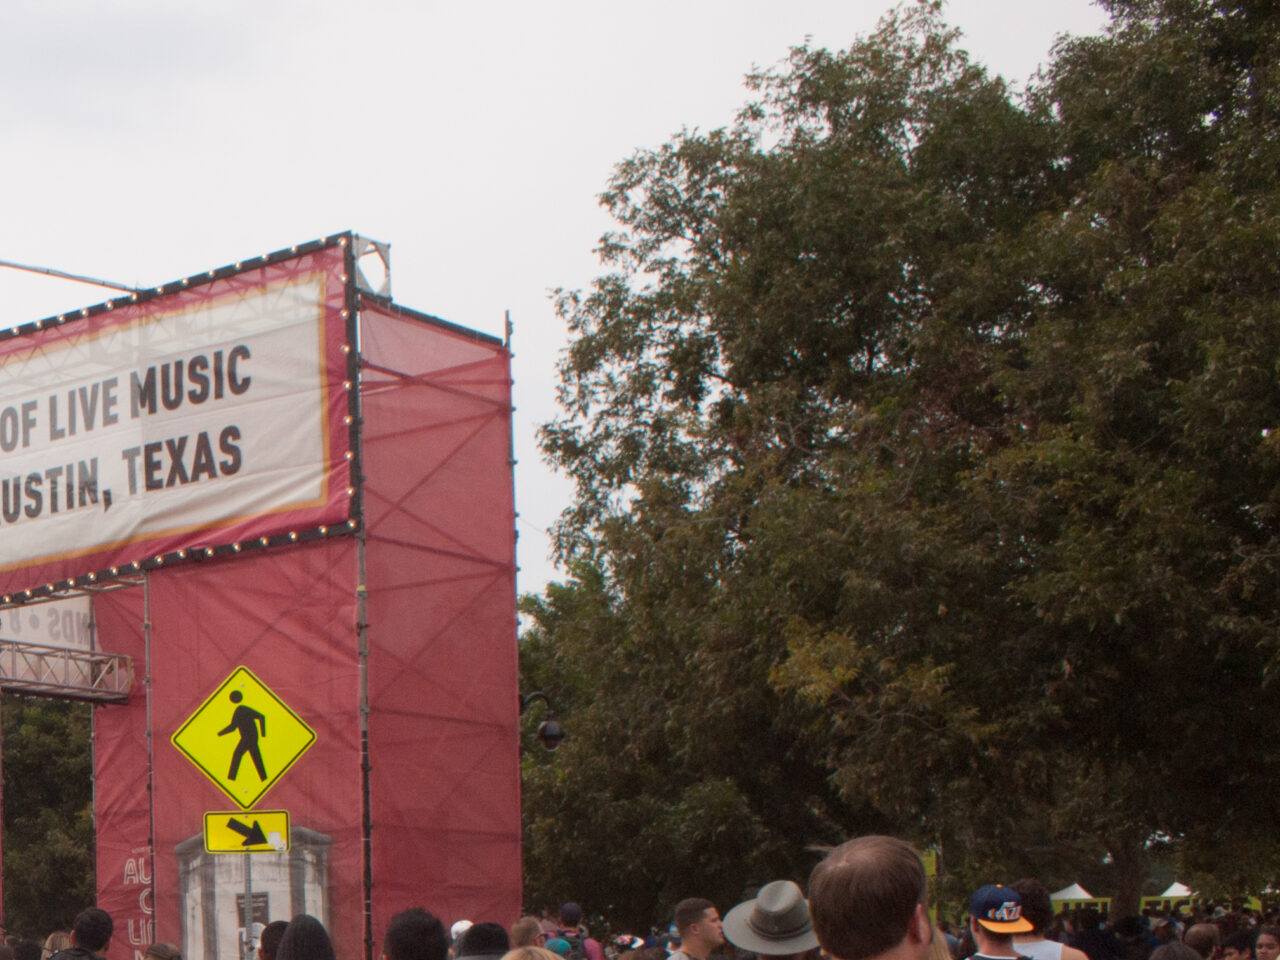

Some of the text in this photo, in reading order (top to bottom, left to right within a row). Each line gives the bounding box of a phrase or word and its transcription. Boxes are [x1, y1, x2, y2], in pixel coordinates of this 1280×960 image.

[0, 400, 38, 453] OF
[49, 376, 119, 441] LIVE
[130, 344, 251, 419] MUSIC
[122, 425, 242, 496] TEXAS
